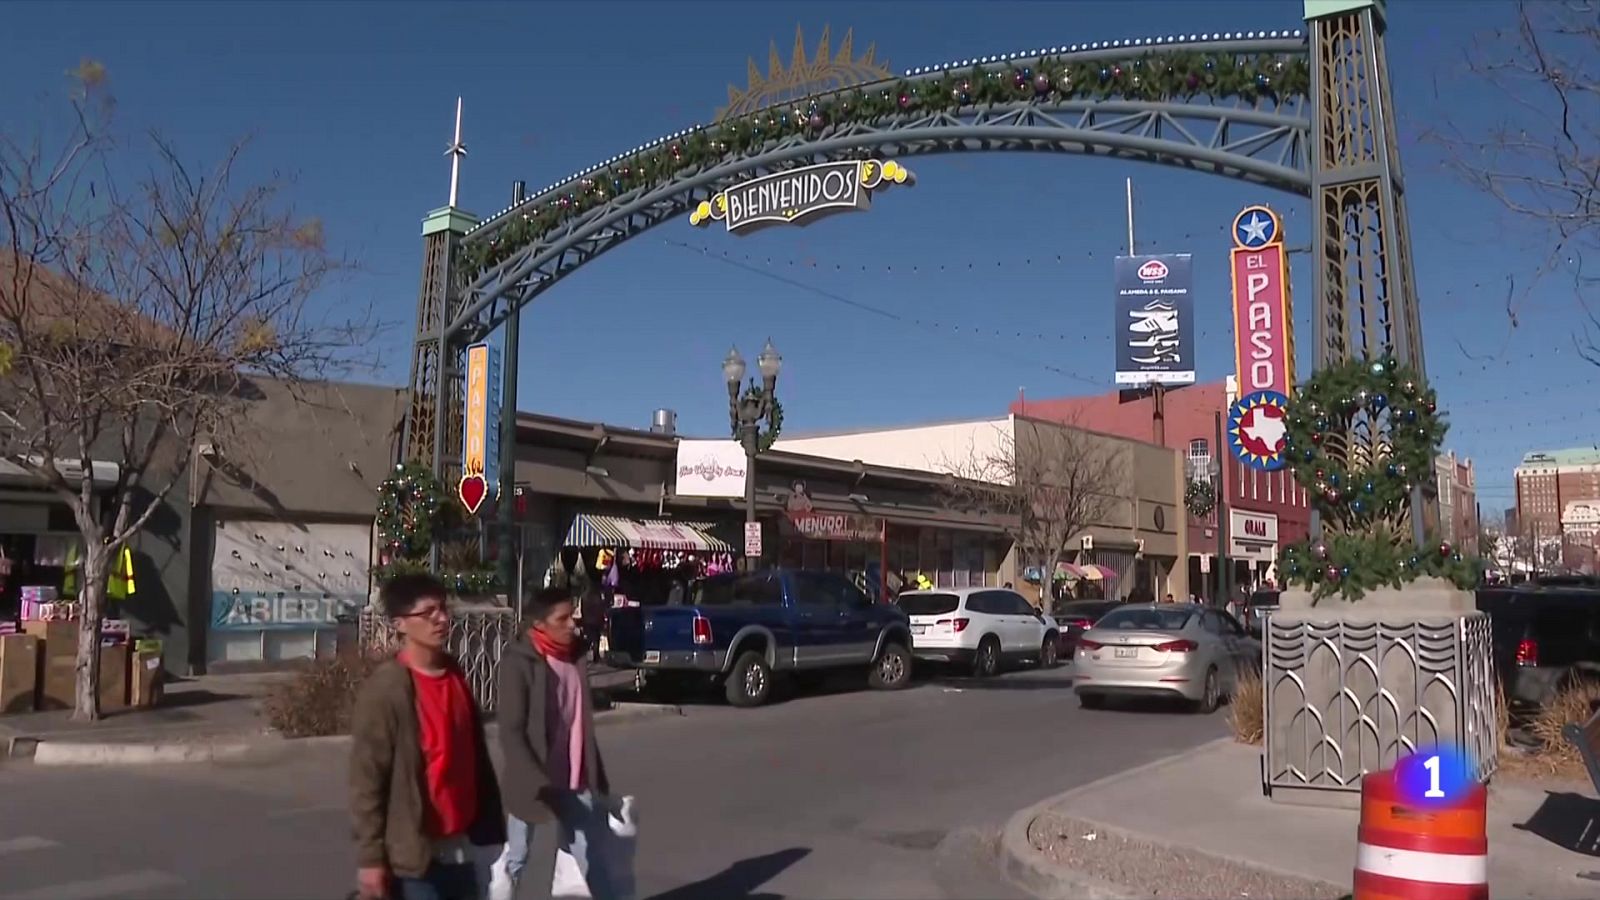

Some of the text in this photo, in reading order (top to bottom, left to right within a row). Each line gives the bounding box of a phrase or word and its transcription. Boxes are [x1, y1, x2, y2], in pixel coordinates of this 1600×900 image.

[730, 169, 854, 221] BIENVENIDOS
[1142, 266, 1164, 276] WSS
[1246, 254, 1268, 269] EL
[1247, 273, 1274, 389] PASO
[470, 367, 482, 455] PASO
